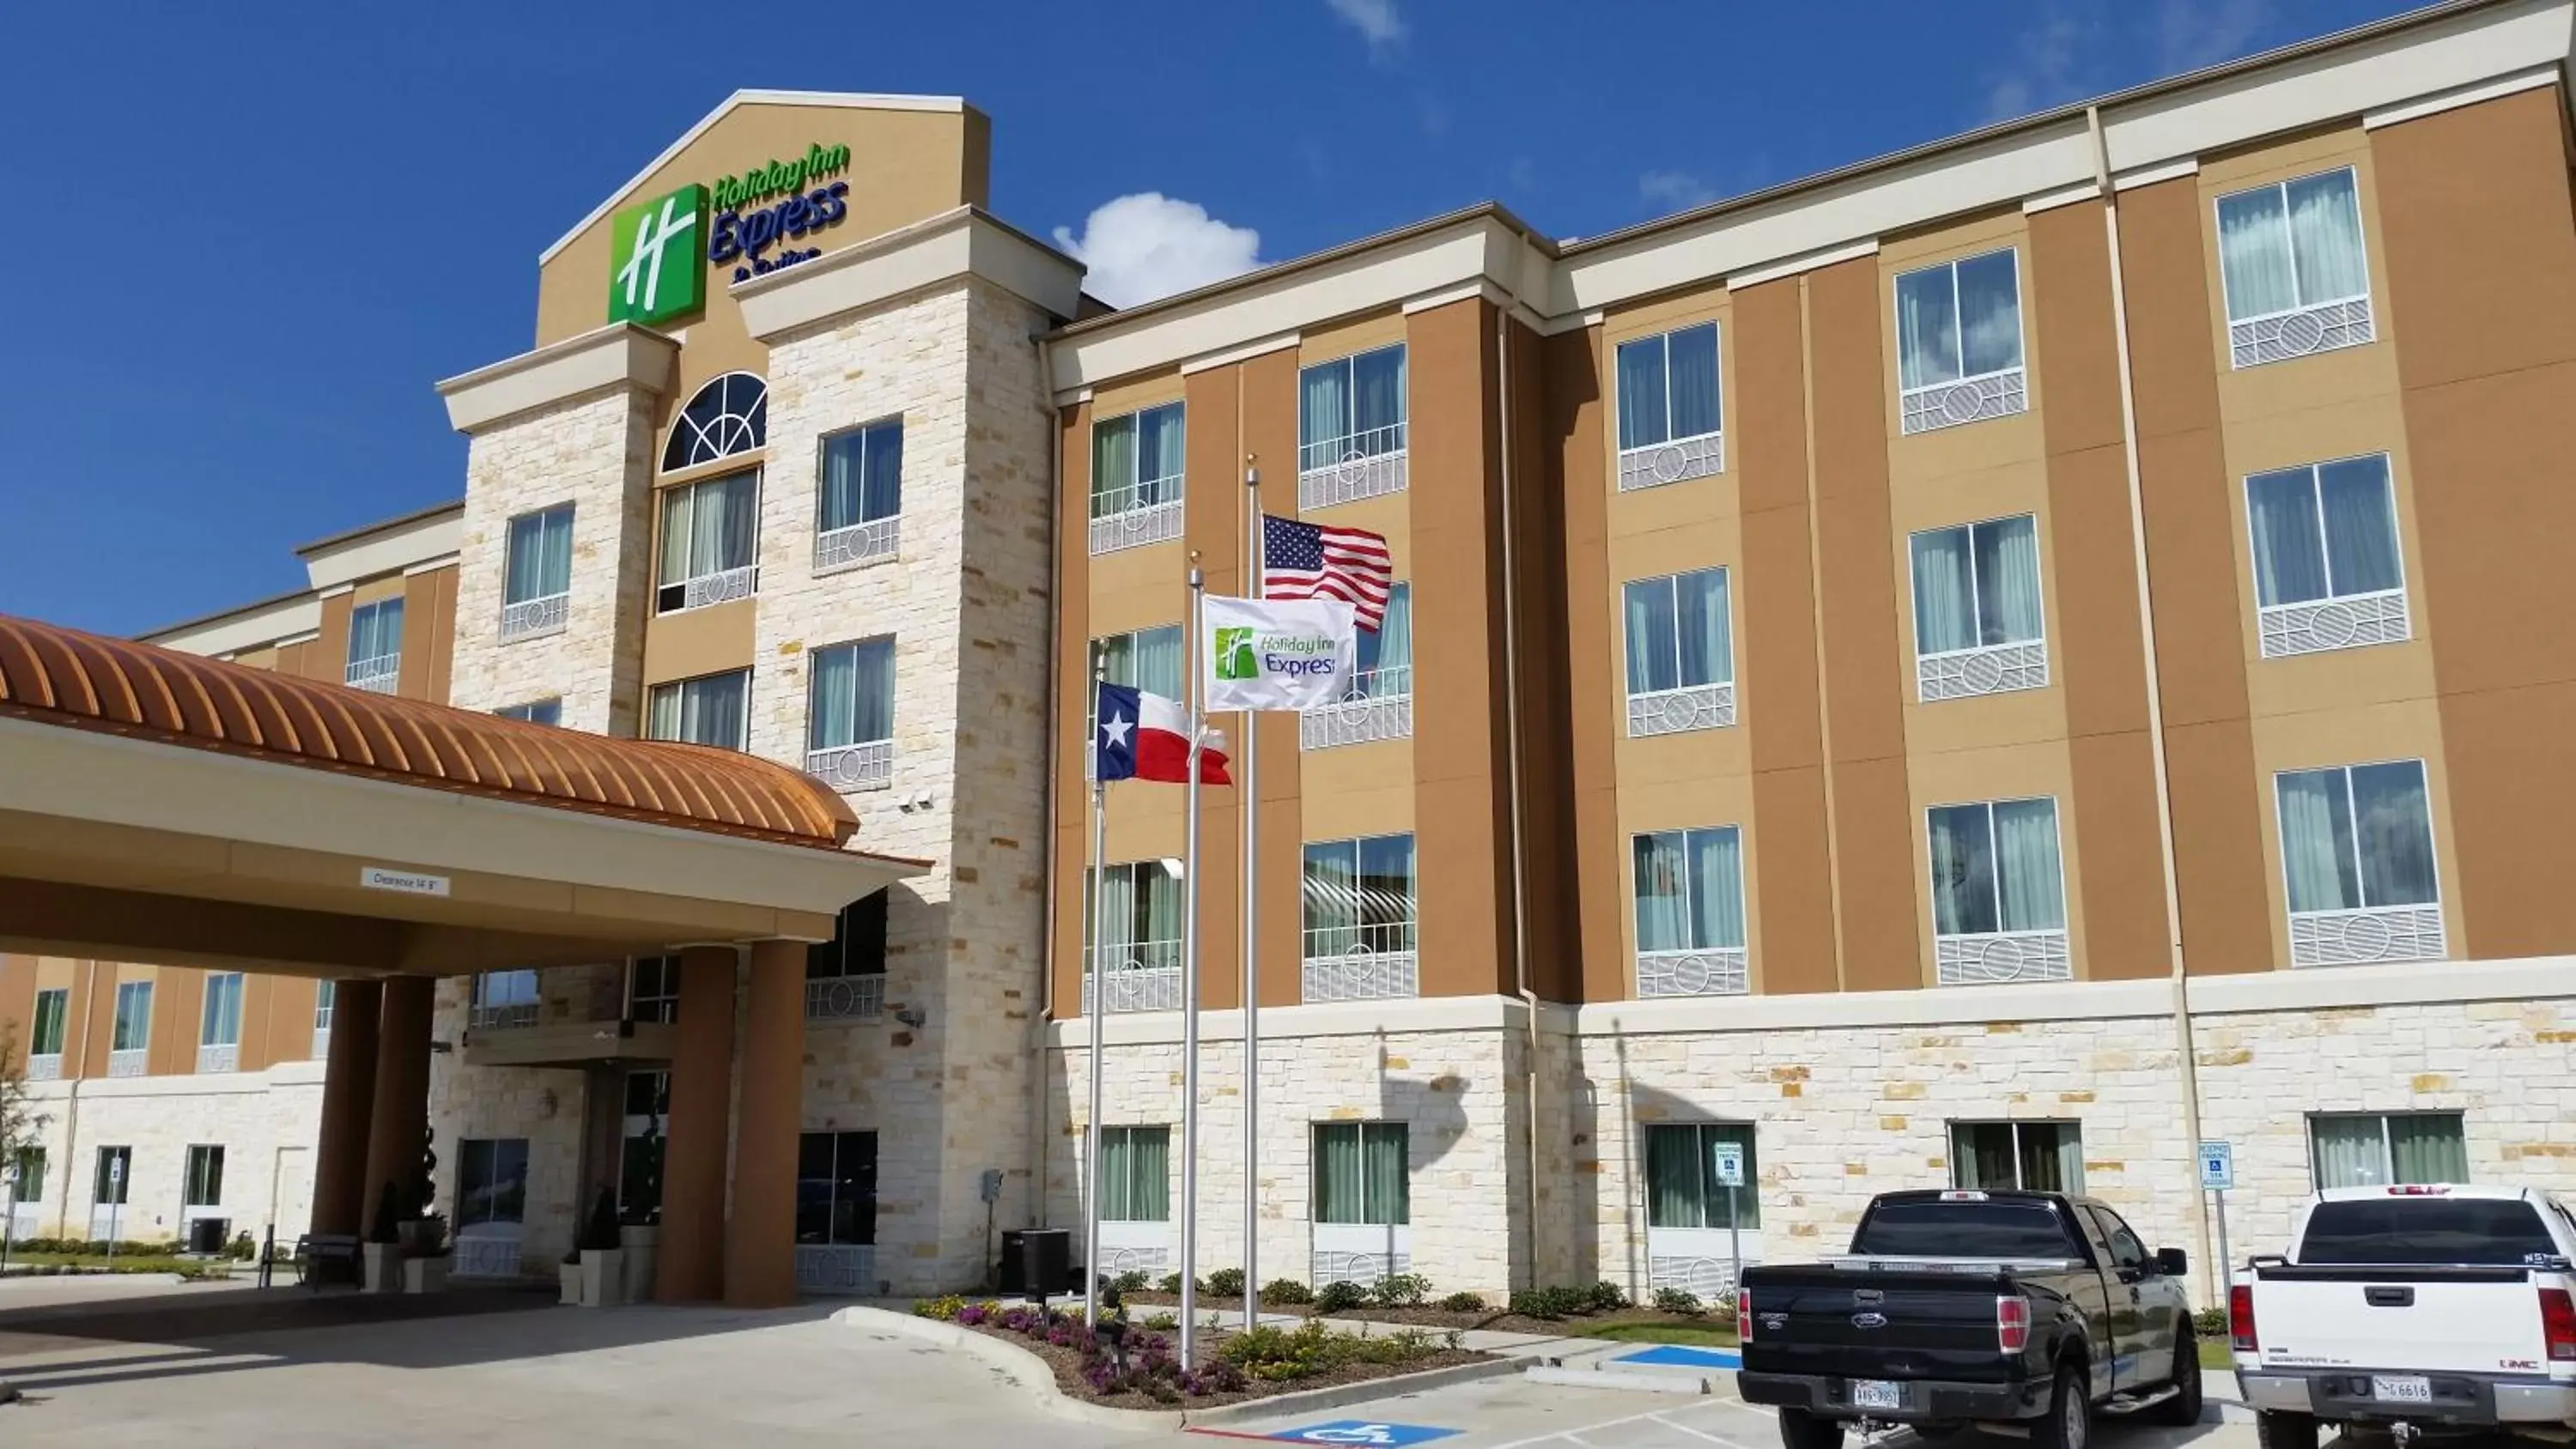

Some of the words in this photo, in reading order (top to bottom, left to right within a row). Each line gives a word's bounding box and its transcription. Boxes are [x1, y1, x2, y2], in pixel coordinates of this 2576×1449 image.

[711, 158, 807, 212] Holiday
[805, 142, 851, 178] Inn
[708, 181, 849, 262] Express
[1261, 636, 1315, 655] Holiday
[1316, 635, 1335, 651] Inn
[1266, 653, 1335, 678] Expres
